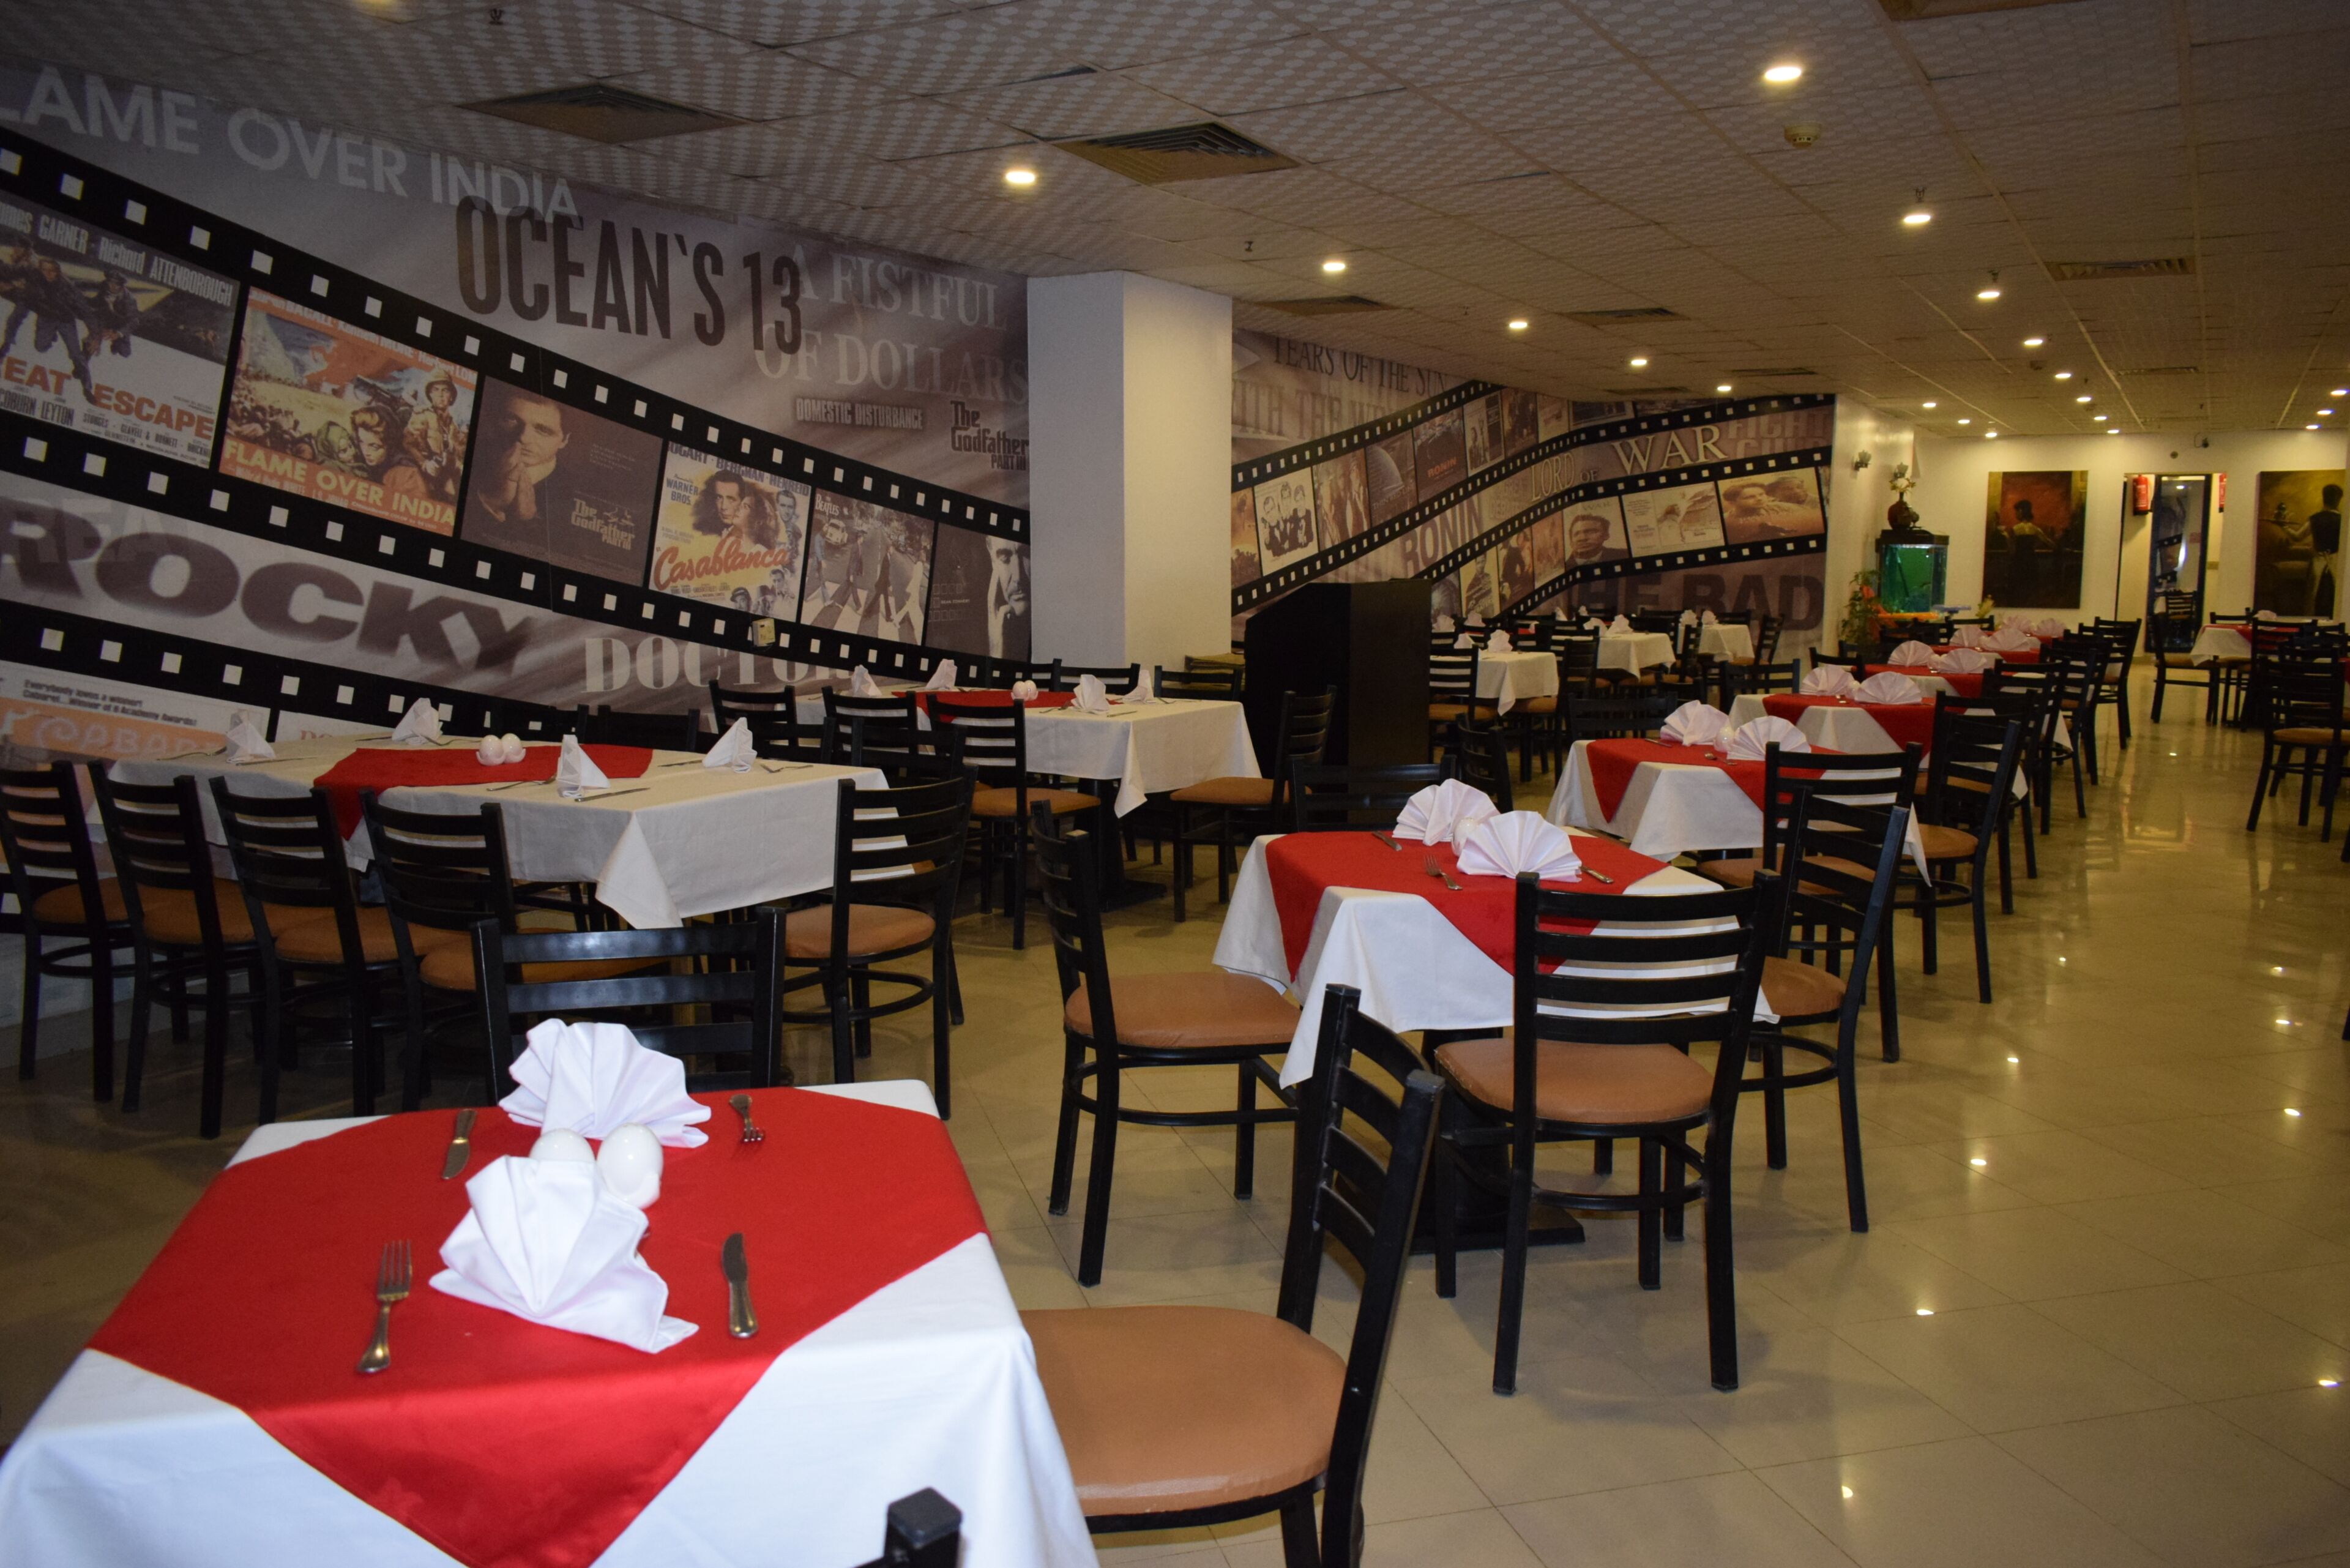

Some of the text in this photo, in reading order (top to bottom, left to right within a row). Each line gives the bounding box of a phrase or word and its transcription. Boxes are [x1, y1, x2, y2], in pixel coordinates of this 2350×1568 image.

[228, 108, 408, 197] OVER
[430, 152, 582, 228] INDIA
[37, 214, 89, 255] GARNER
[150, 256, 233, 306] ATTENBOROUGH
[744, 252, 802, 354] 13
[830, 252, 1007, 331] FISTFUL
[755, 323, 1028, 403] OF DOLLARS
[1273, 337, 1335, 376] TEARS
[1343, 351, 1369, 383] OF
[1378, 359, 1409, 392] THE
[93, 383, 215, 441] ESCAPE
[796, 398, 923, 430] DOMESTIC DISTURBANCE
[950, 400, 980, 428] The
[950, 427, 1029, 455] Godfather
[991, 454, 1015, 470] PART
[1428, 456, 1457, 478] RONIN
[1531, 453, 1574, 501] LORD
[1580, 469, 1598, 482] OF
[1611, 424, 1728, 475] WAR
[223, 439, 308, 482] FLAME
[316, 469, 383, 507] OVER
[392, 493, 455, 526] INDIA
[573, 498, 597, 518] The
[666, 477, 699, 496] WARNER
[571, 512, 635, 542] Godfather
[602, 534, 623, 548] PART
[1400, 493, 1482, 579] RONIN
[0, 497, 535, 675] ROCKY
[654, 527, 789, 591] Casablanca
[1683, 574, 1824, 630] BAD
